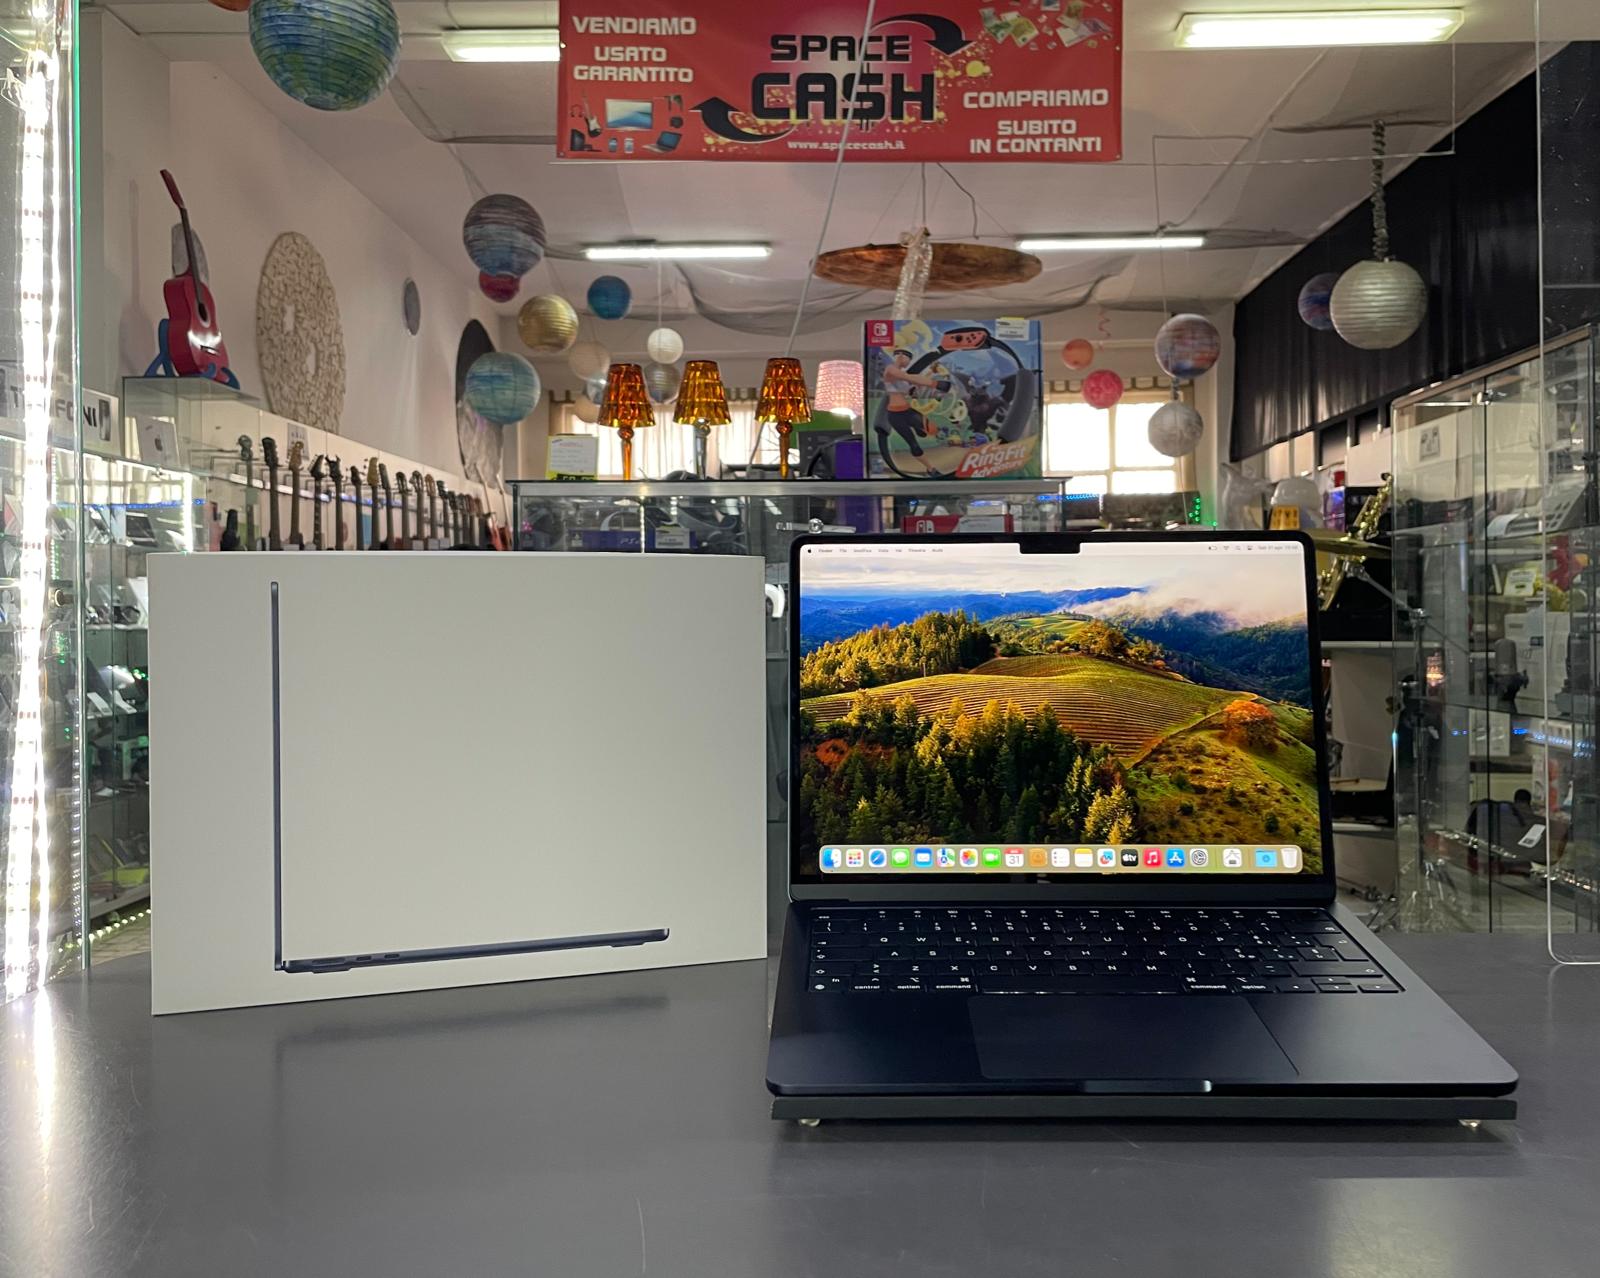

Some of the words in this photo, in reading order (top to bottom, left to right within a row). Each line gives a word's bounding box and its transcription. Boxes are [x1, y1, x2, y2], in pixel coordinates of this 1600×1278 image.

[572, 16, 697, 35] VENDIAMO
[594, 46, 667, 62] USATO
[770, 34, 910, 62] SPACE
[573, 65, 694, 83] GARANTITO
[963, 88, 1109, 109] COMPRIAMO
[997, 119, 1077, 135] SUBITO
[787, 140, 906, 151] www.spcecash.it
[969, 138, 991, 154] IN
[996, 136, 1102, 153] CONTANTI
[1008, 855, 1020, 865] 31
